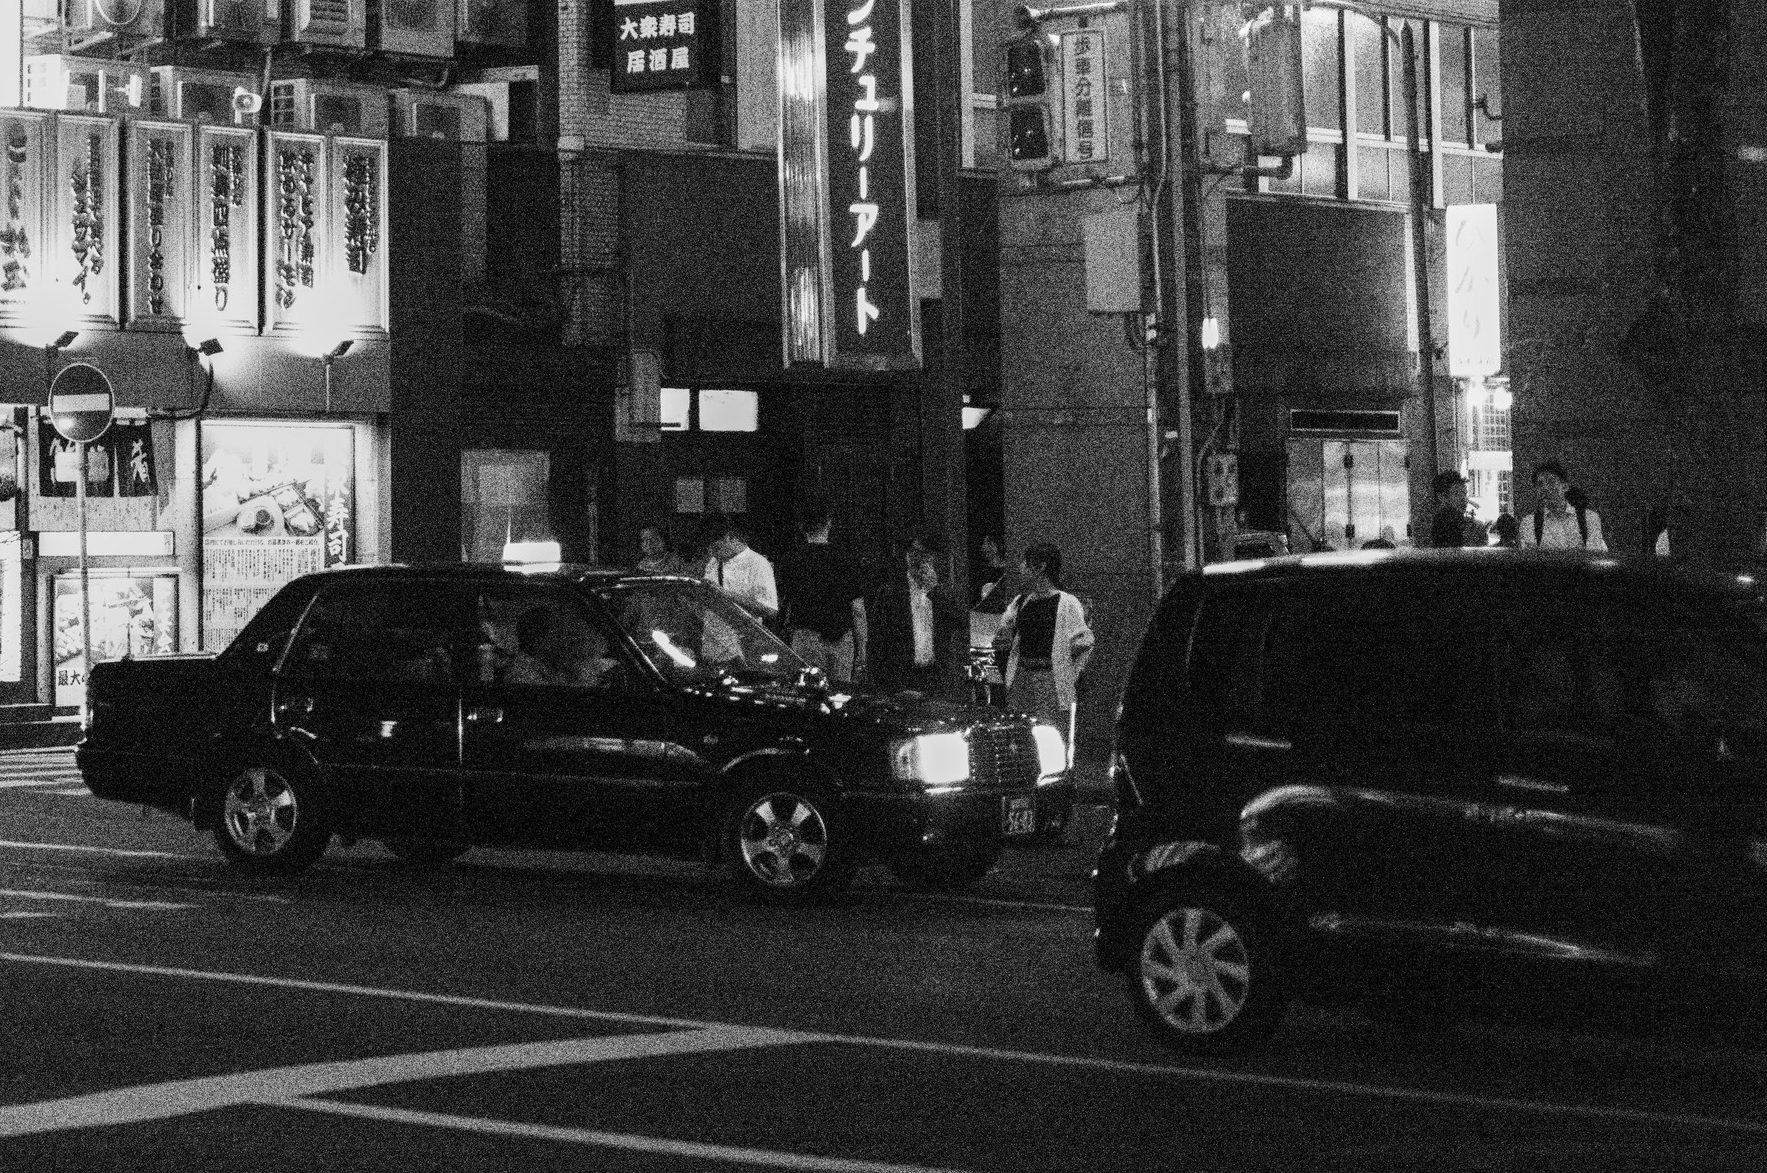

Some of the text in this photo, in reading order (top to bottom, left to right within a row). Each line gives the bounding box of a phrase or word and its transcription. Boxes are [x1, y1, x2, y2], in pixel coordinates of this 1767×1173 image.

[619, 11, 695, 40] 大衆寿司
[625, 45, 690, 74] 居酒屋
[1074, 35, 1095, 160] 歩車分離信号
[57, 669, 85, 686] 最大
